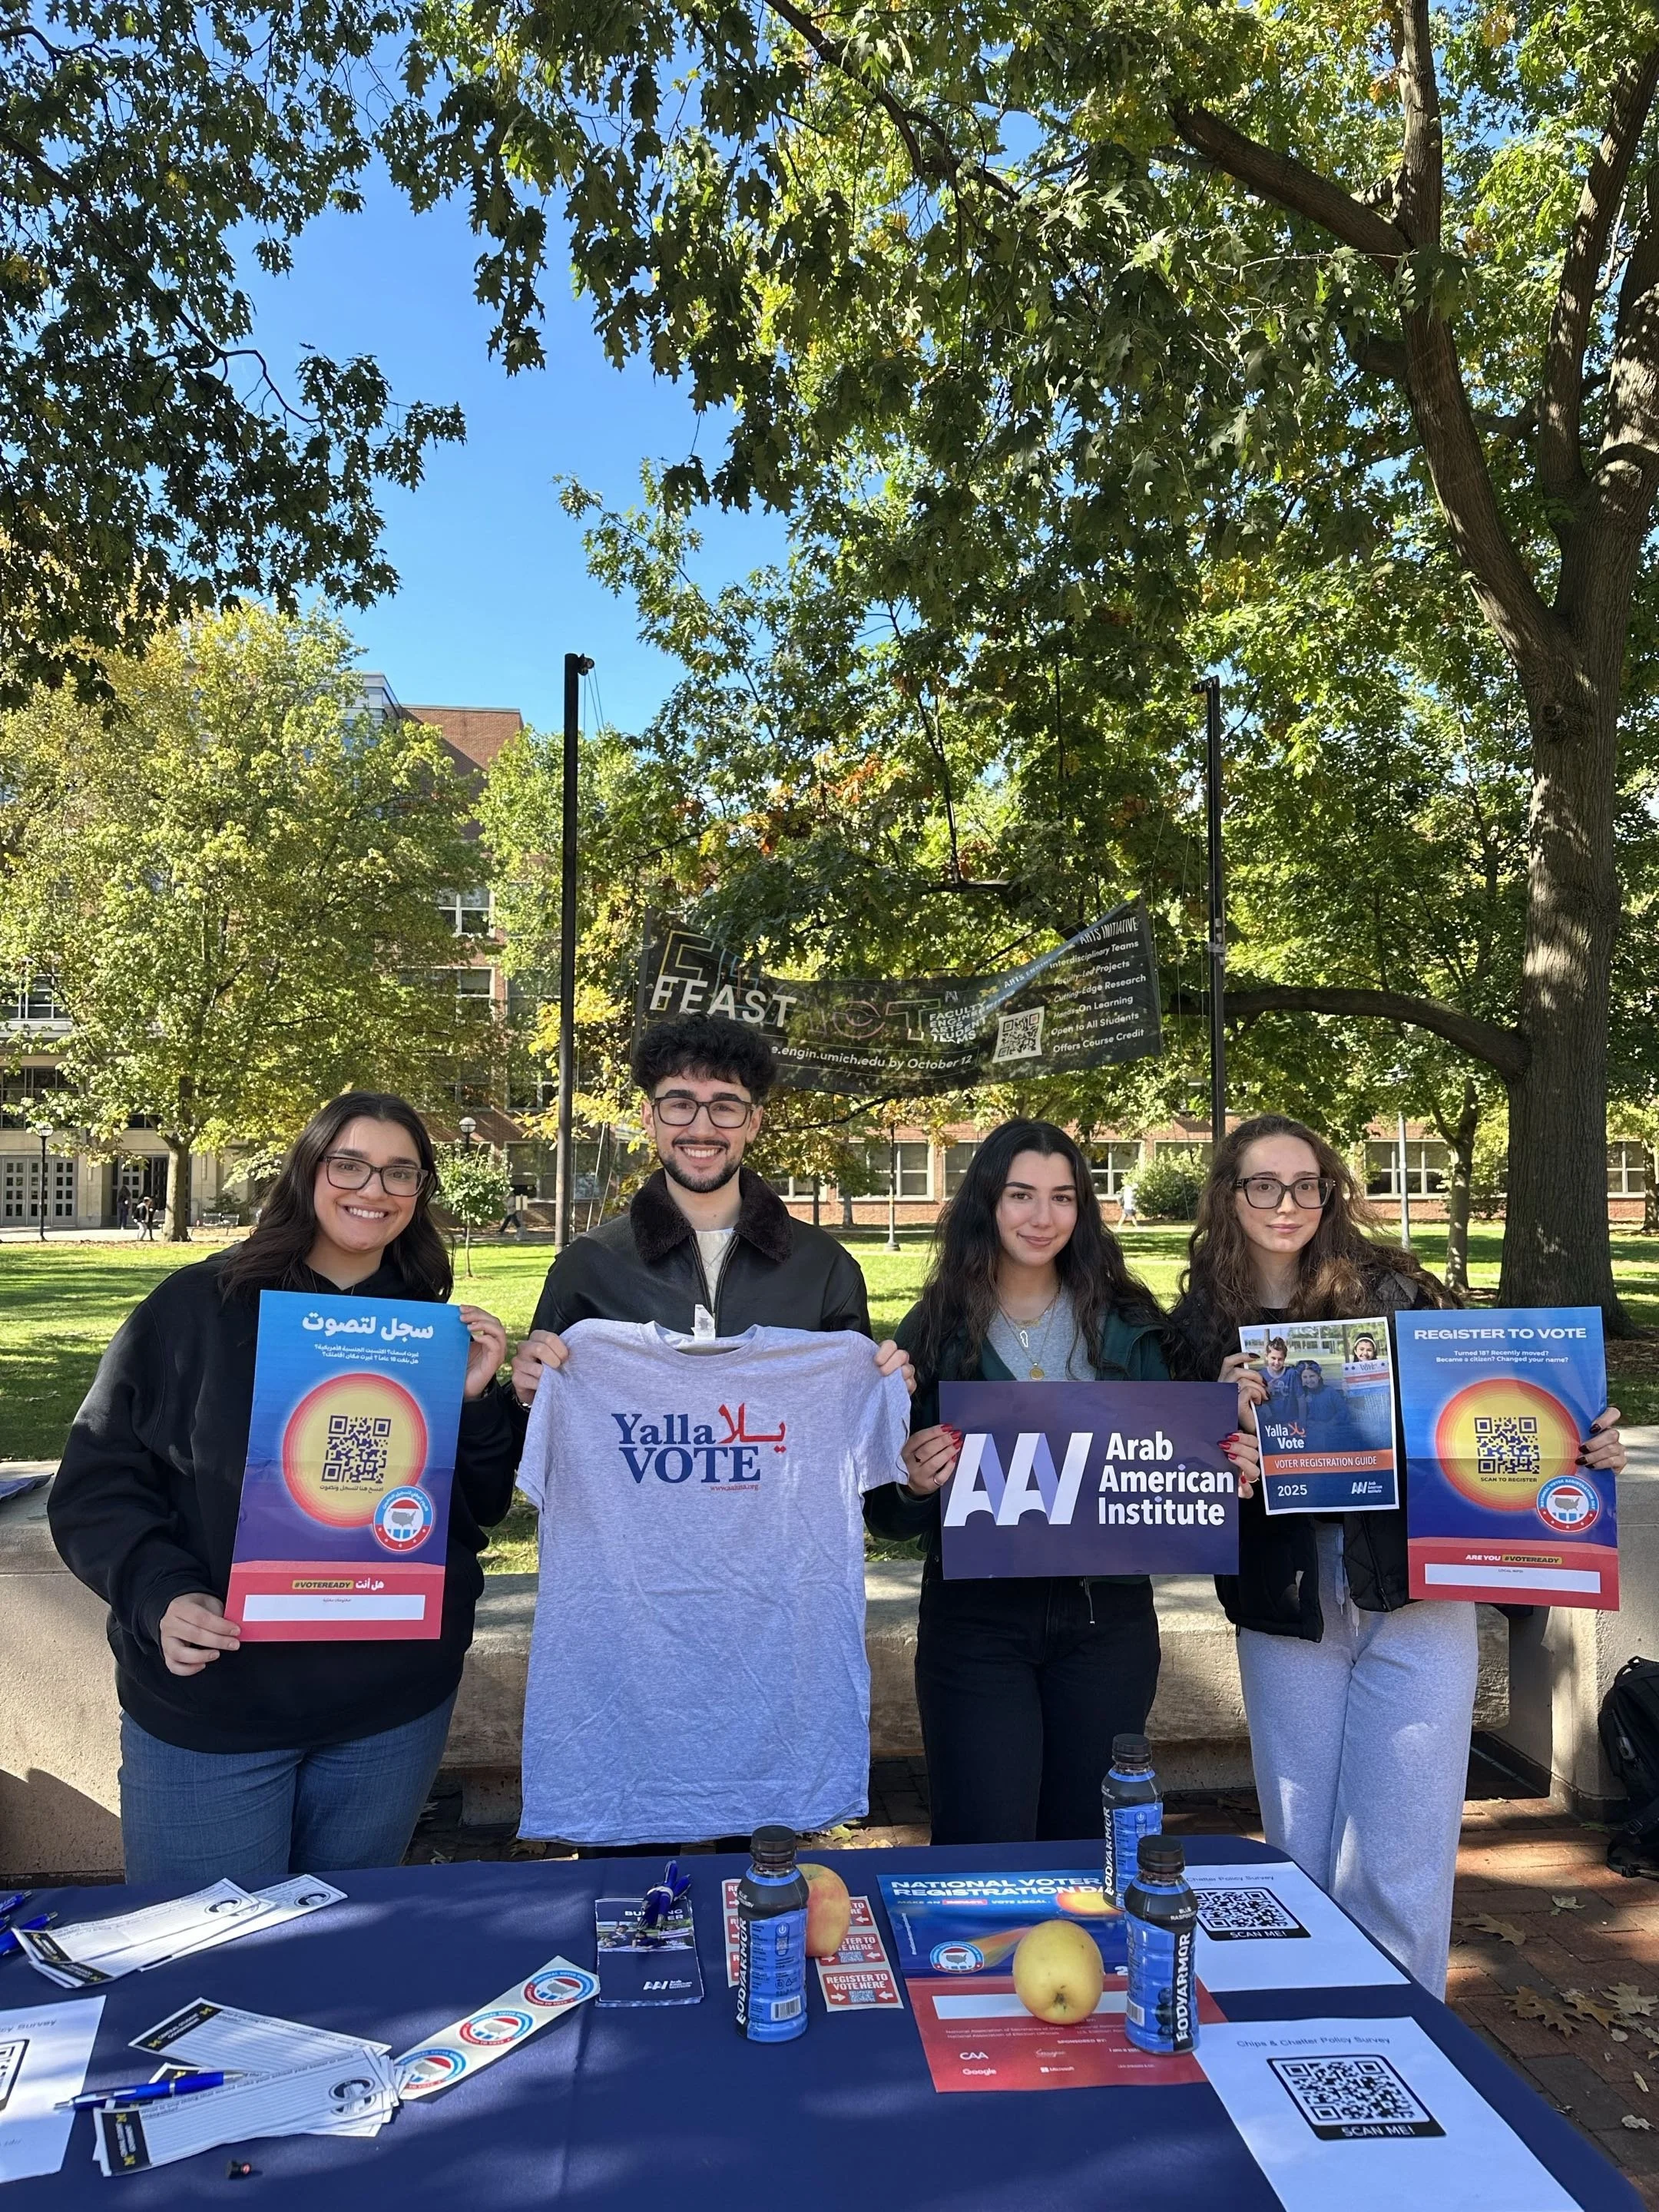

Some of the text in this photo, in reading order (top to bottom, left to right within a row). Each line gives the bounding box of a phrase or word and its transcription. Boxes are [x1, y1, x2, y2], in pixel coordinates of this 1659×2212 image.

[1080, 916, 1138, 945] ARTS INITIATIVE
[1049, 940, 1139, 969] Interdisciplinary Teams
[1004, 974, 1025, 988] ARTS
[1054, 960, 1130, 986] Faculty-Led Projects
[1054, 974, 1146, 1003] Cutting-Edge Research
[650, 975, 797, 1028] FEAST
[929, 1000, 986, 1021] FACULTY
[1053, 995, 1134, 1019] Hands-On Learning
[930, 1022, 963, 1033] ARTS
[931, 1015, 987, 1039] TUDENT
[1051, 1012, 1140, 1037] Open to All Students
[1053, 1028, 1144, 1053] Offers Course Credit
[771, 1045, 972, 1070] e.engin.umich.edu by October 12
[303, 1312, 434, 1343] سجل لتصوت
[1414, 1327, 1587, 1340] REGISTER TO VOTE
[611, 1413, 716, 1445] Yalla
[718, 1402, 786, 1454] يلا
[1265, 1423, 1289, 1437] Yalla
[1106, 1431, 1174, 1461] Arab
[1277, 1437, 1305, 1449] Vote
[618, 1446, 760, 1484] VOTE
[1274, 1455, 1377, 1469] VOTER REGISTRATION GUIDE
[1098, 1464, 1234, 1493] American
[1277, 1485, 1307, 1497] 2025
[1098, 1496, 1225, 1526] Institute
[1505, 1555, 1560, 1564] #VOTEREADY
[356, 1578, 384, 1591] هل أنت
[1104, 1806, 1114, 1896] BODYARMOR
[891, 1878, 1102, 1889] NATIONAL VOTER
[893, 1886, 1076, 1896] REGISTRATION
[737, 1917, 747, 2025] BODYARMOR
[826, 1974, 874, 1984] REGISTER
[1176, 1932, 1190, 2042] BODYARMOR
[17, 2019, 57, 2030] Survey
[1320, 2036, 1351, 2045] Policy
[1354, 2036, 1390, 2045] Survey
[960, 2051, 988, 2060] CAA
[1341, 2124, 1416, 2137] SCAN ME!
